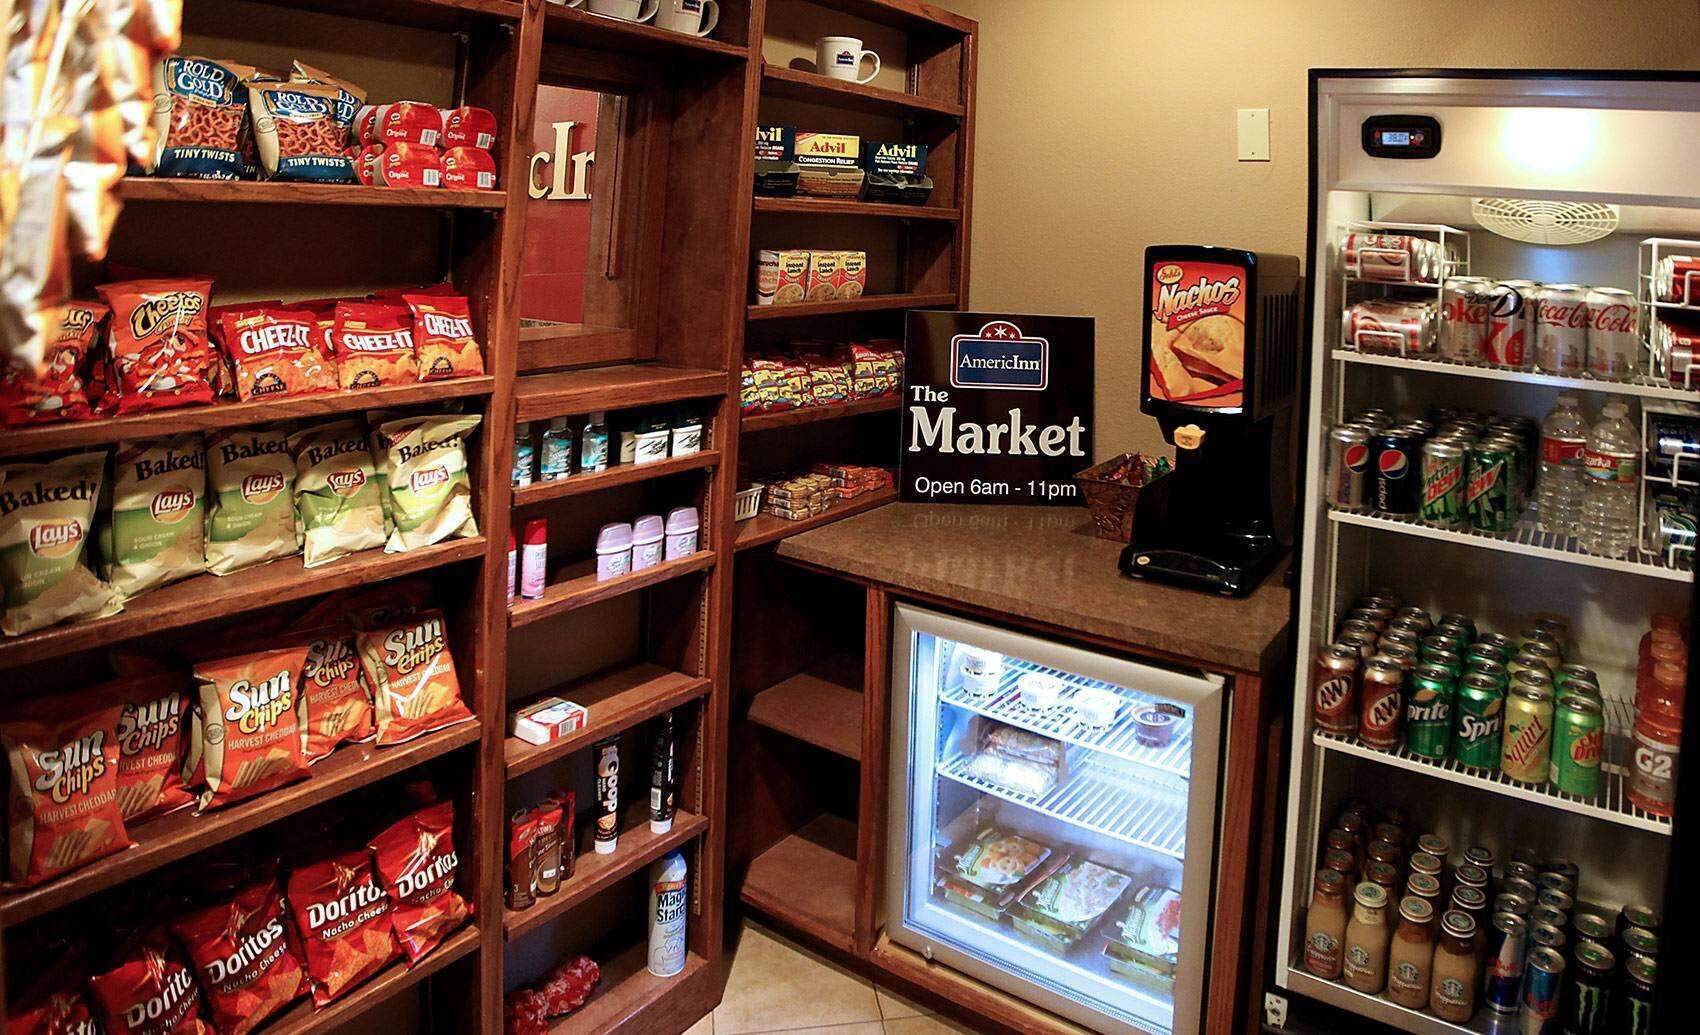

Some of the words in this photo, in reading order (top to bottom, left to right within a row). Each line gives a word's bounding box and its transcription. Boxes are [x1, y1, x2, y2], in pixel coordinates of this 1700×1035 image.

[183, 59, 224, 83] ROLD
[177, 74, 224, 99] GOLD
[174, 149, 201, 161] TINY
[201, 150, 236, 163] TWISTS
[288, 158, 311, 167] TINY
[312, 157, 346, 168] TWISTS
[810, 141, 847, 154] Advil
[876, 143, 917, 158] Advil
[1153, 277, 1240, 321] Nachos
[131, 292, 203, 340] Cheetos
[424, 313, 473, 338] CHEEZ-IT
[240, 324, 311, 354] CHEEZ-IT
[342, 331, 415, 351] CHEEZ-IT
[959, 354, 1041, 371] AmericInn
[910, 385, 949, 402] The
[908, 406, 1086, 457] Market
[222, 437, 289, 466] Baked
[309, 437, 370, 467] Baked
[915, 476, 965, 498] Open
[970, 478, 1009, 496] 6am
[1028, 480, 1077, 500] 11pm
[384, 618, 442, 668] Sun
[398, 636, 445, 675] Chips
[314, 657, 354, 687] Chips
[226, 669, 291, 722] Sun
[117, 692, 181, 741] Sun
[239, 690, 292, 735] Chips
[122, 715, 180, 756] Chips
[228, 734, 265, 750] HARVEST
[265, 725, 297, 745] CHEDDAR
[35, 730, 104, 792] Sun
[1635, 747, 1673, 779] G2
[52, 756, 105, 804] Chips
[39, 806, 78, 825] HARVEST
[395, 850, 459, 899] Doritos
[306, 881, 388, 930] Dorito
[322, 919, 355, 940] Nacho
[204, 917, 284, 985] Doritos
[223, 969, 259, 993] Nacho
